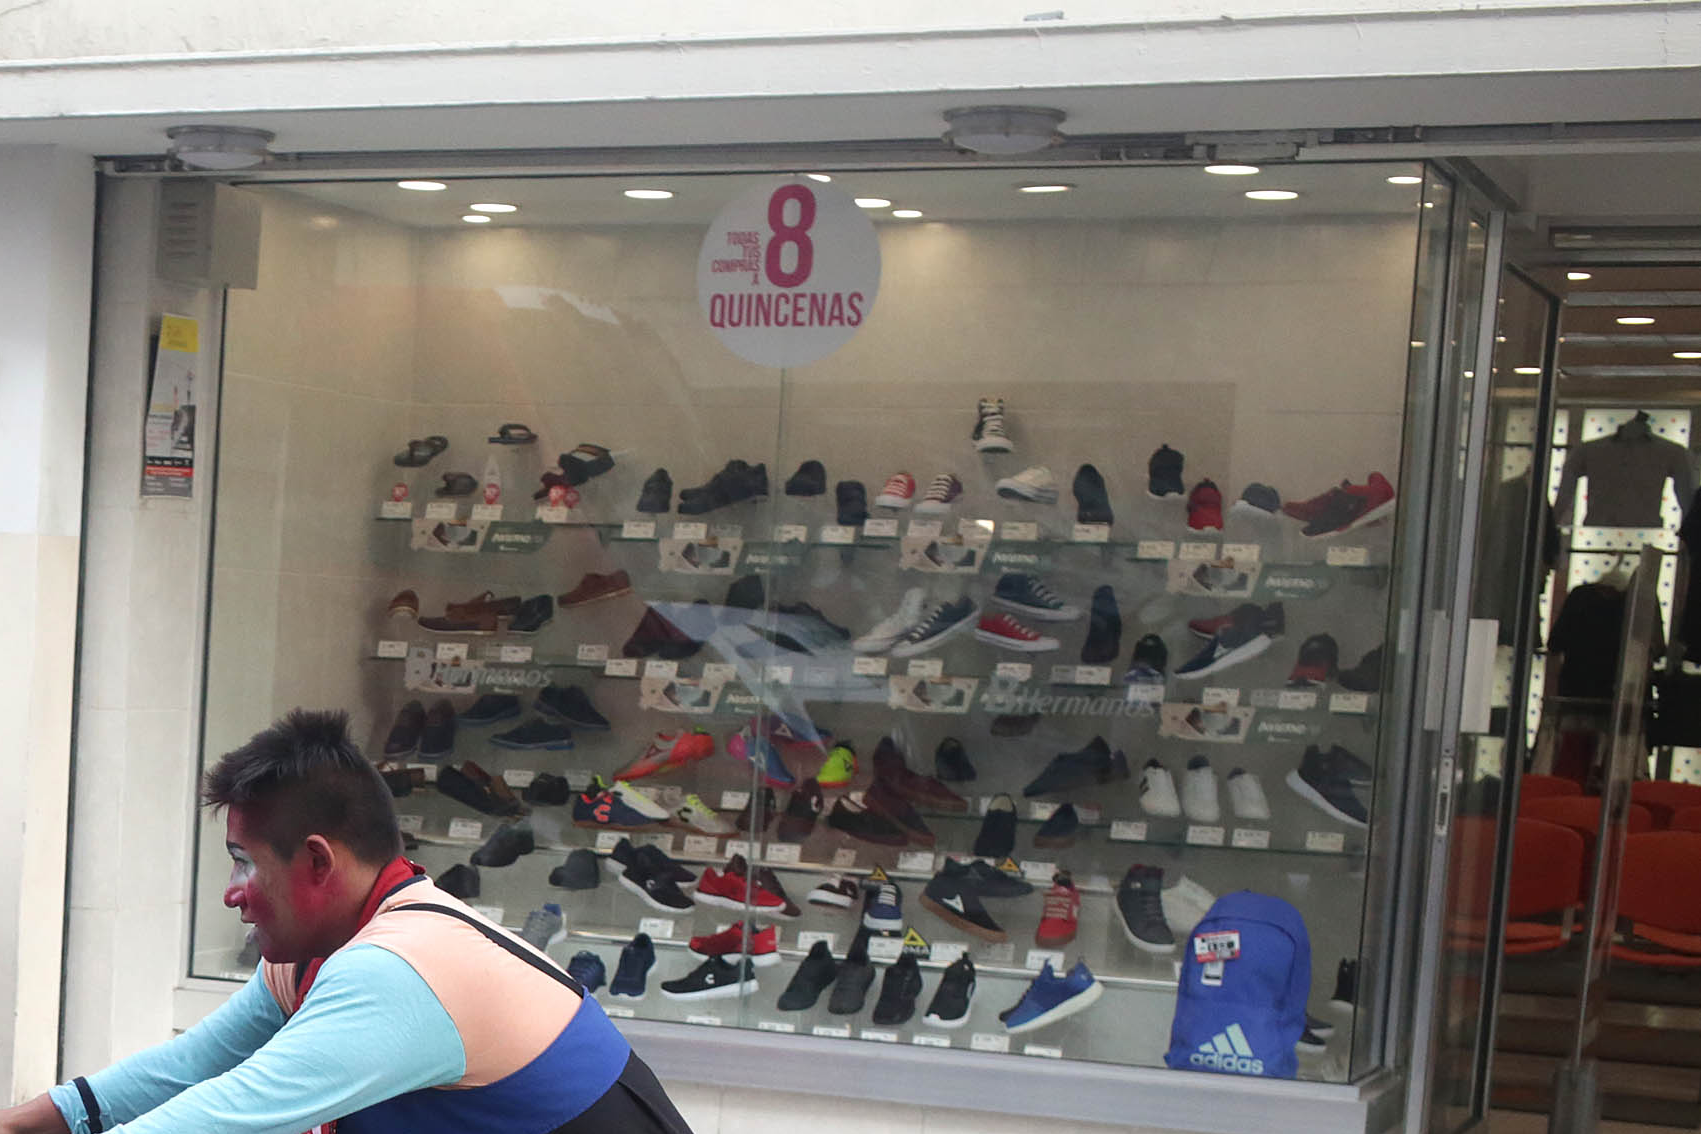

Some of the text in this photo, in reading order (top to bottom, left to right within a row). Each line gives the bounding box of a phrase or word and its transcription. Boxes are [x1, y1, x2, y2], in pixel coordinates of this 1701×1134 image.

[765, 184, 816, 288] 8
[710, 292, 864, 328] QUINCENAS
[1019, 688, 1155, 717] Hermanos
[1190, 1053, 1264, 1074] adidas
